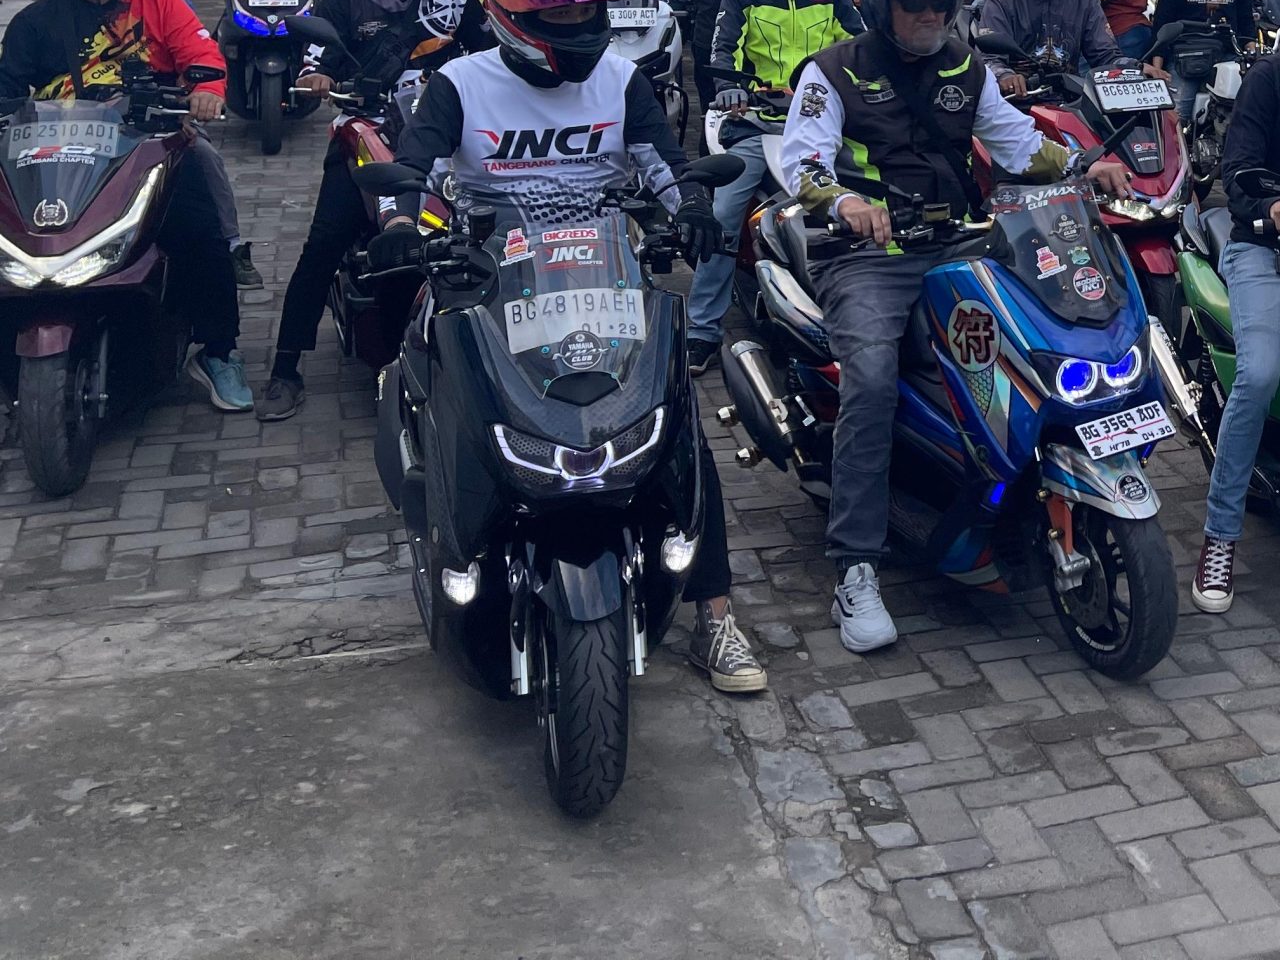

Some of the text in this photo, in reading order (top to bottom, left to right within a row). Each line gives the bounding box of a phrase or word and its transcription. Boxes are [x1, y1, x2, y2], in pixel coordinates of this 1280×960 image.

[640, 9, 655, 19] ACT
[91, 63, 116, 80] Club
[12, 126, 31, 142] BG
[37, 123, 79, 138] 2510
[482, 159, 557, 173] TANGERANG
[1025, 185, 1077, 204] NMAX
[1028, 199, 1049, 210] CLUB
[544, 230, 597, 241] BIGREDS
[568, 342, 594, 351] YAMAHA
[571, 355, 593, 363] CLUB
[1080, 403, 1161, 441] BG 3569 ADF
